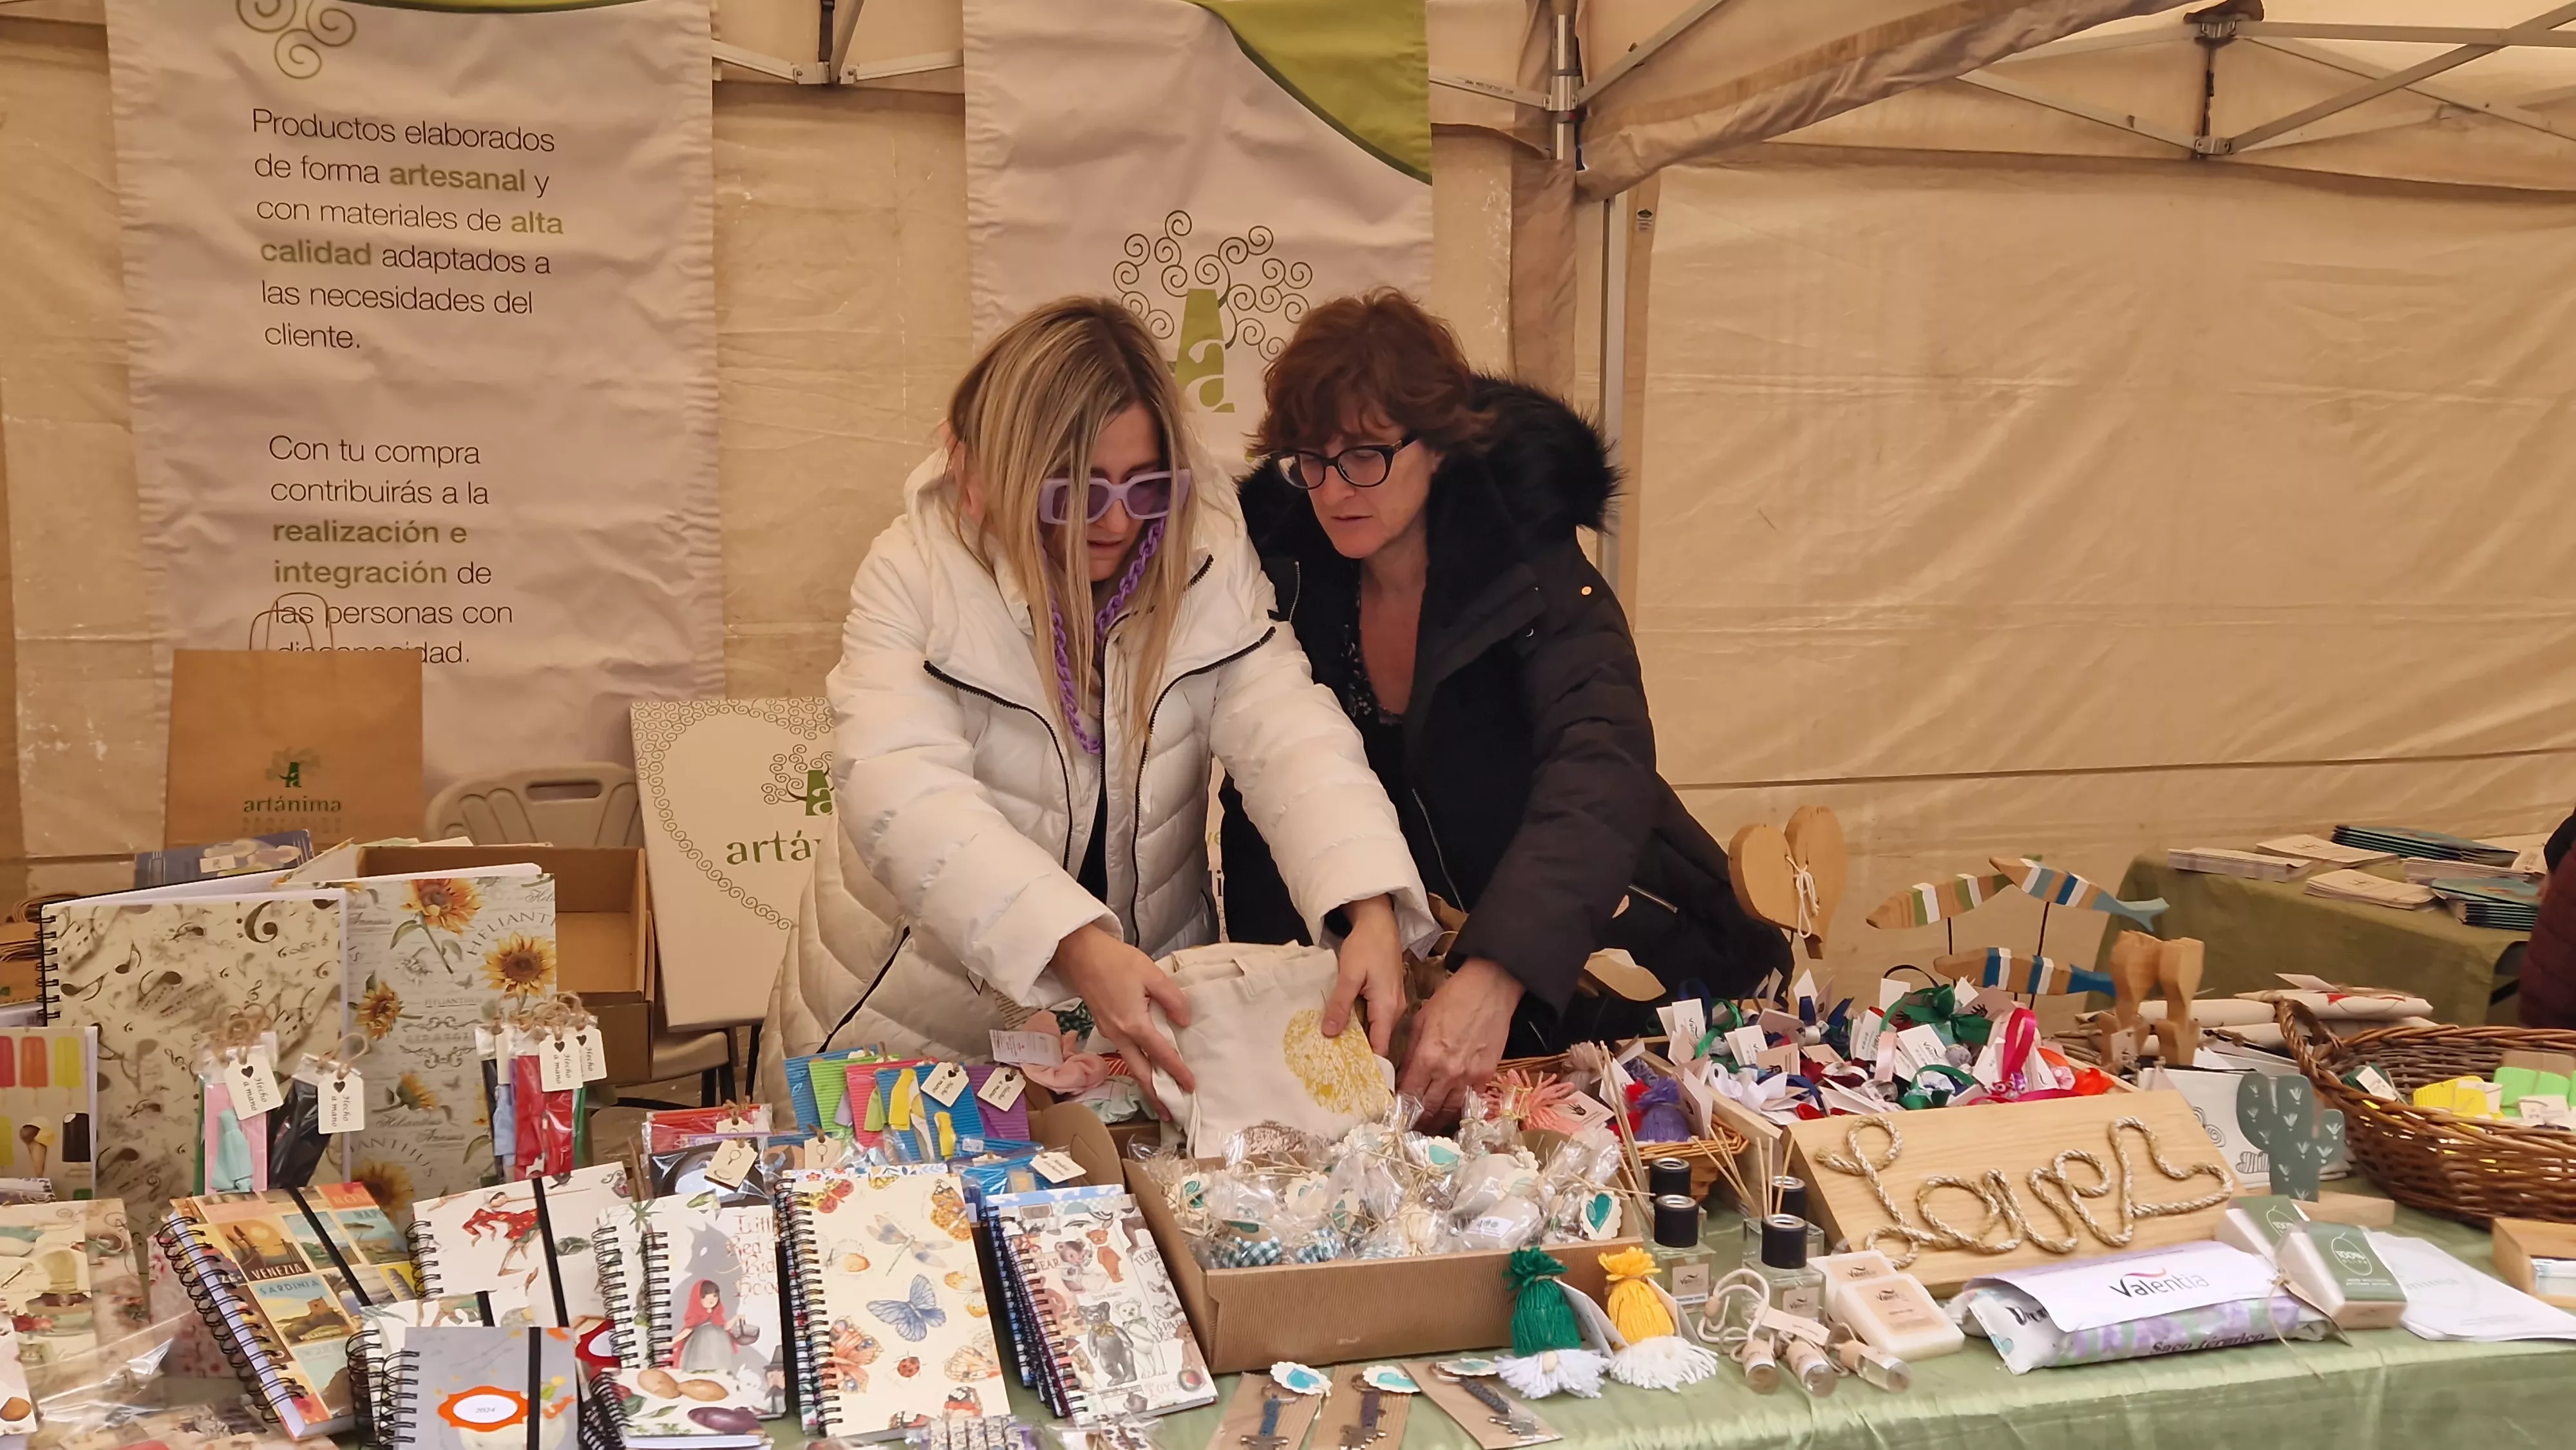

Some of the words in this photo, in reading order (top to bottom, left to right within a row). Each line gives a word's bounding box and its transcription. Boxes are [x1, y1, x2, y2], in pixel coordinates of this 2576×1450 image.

[252, 108, 397, 144] Productos
[404, 119, 556, 153] elaborados
[254, 153, 292, 179] de
[300, 155, 381, 185] forma
[388, 164, 526, 193] artesanal
[533, 173, 550, 198] y
[256, 199, 310, 221] con
[319, 201, 459, 231] materiales
[466, 207, 502, 233] de
[510, 210, 565, 236] alta
[260, 238, 372, 267] calidad
[381, 243, 527, 275] adaptados
[534, 255, 552, 275] a
[261, 279, 301, 306] las
[309, 285, 486, 314] necesidades
[493, 289, 533, 315] del
[264, 322, 361, 350] cliente.
[269, 434, 329, 462] Con
[338, 438, 365, 463] tu
[374, 442, 481, 469] compra
[270, 478, 433, 505] contribuirás
[441, 485, 459, 505] a
[466, 480, 490, 506] la
[272, 519, 440, 544] realización
[449, 526, 468, 544] e
[274, 559, 448, 590] integración
[457, 560, 492, 585] de
[275, 601, 315, 626] las
[324, 603, 454, 630] personas
[462, 603, 513, 625] con
[243, 795, 342, 813] artánima
[726, 829, 822, 865] artá
[250, 1263, 304, 1279] VENEZIA
[2108, 1268, 2210, 1298] Valentia
[259, 1279, 320, 1295] SARDINIA
